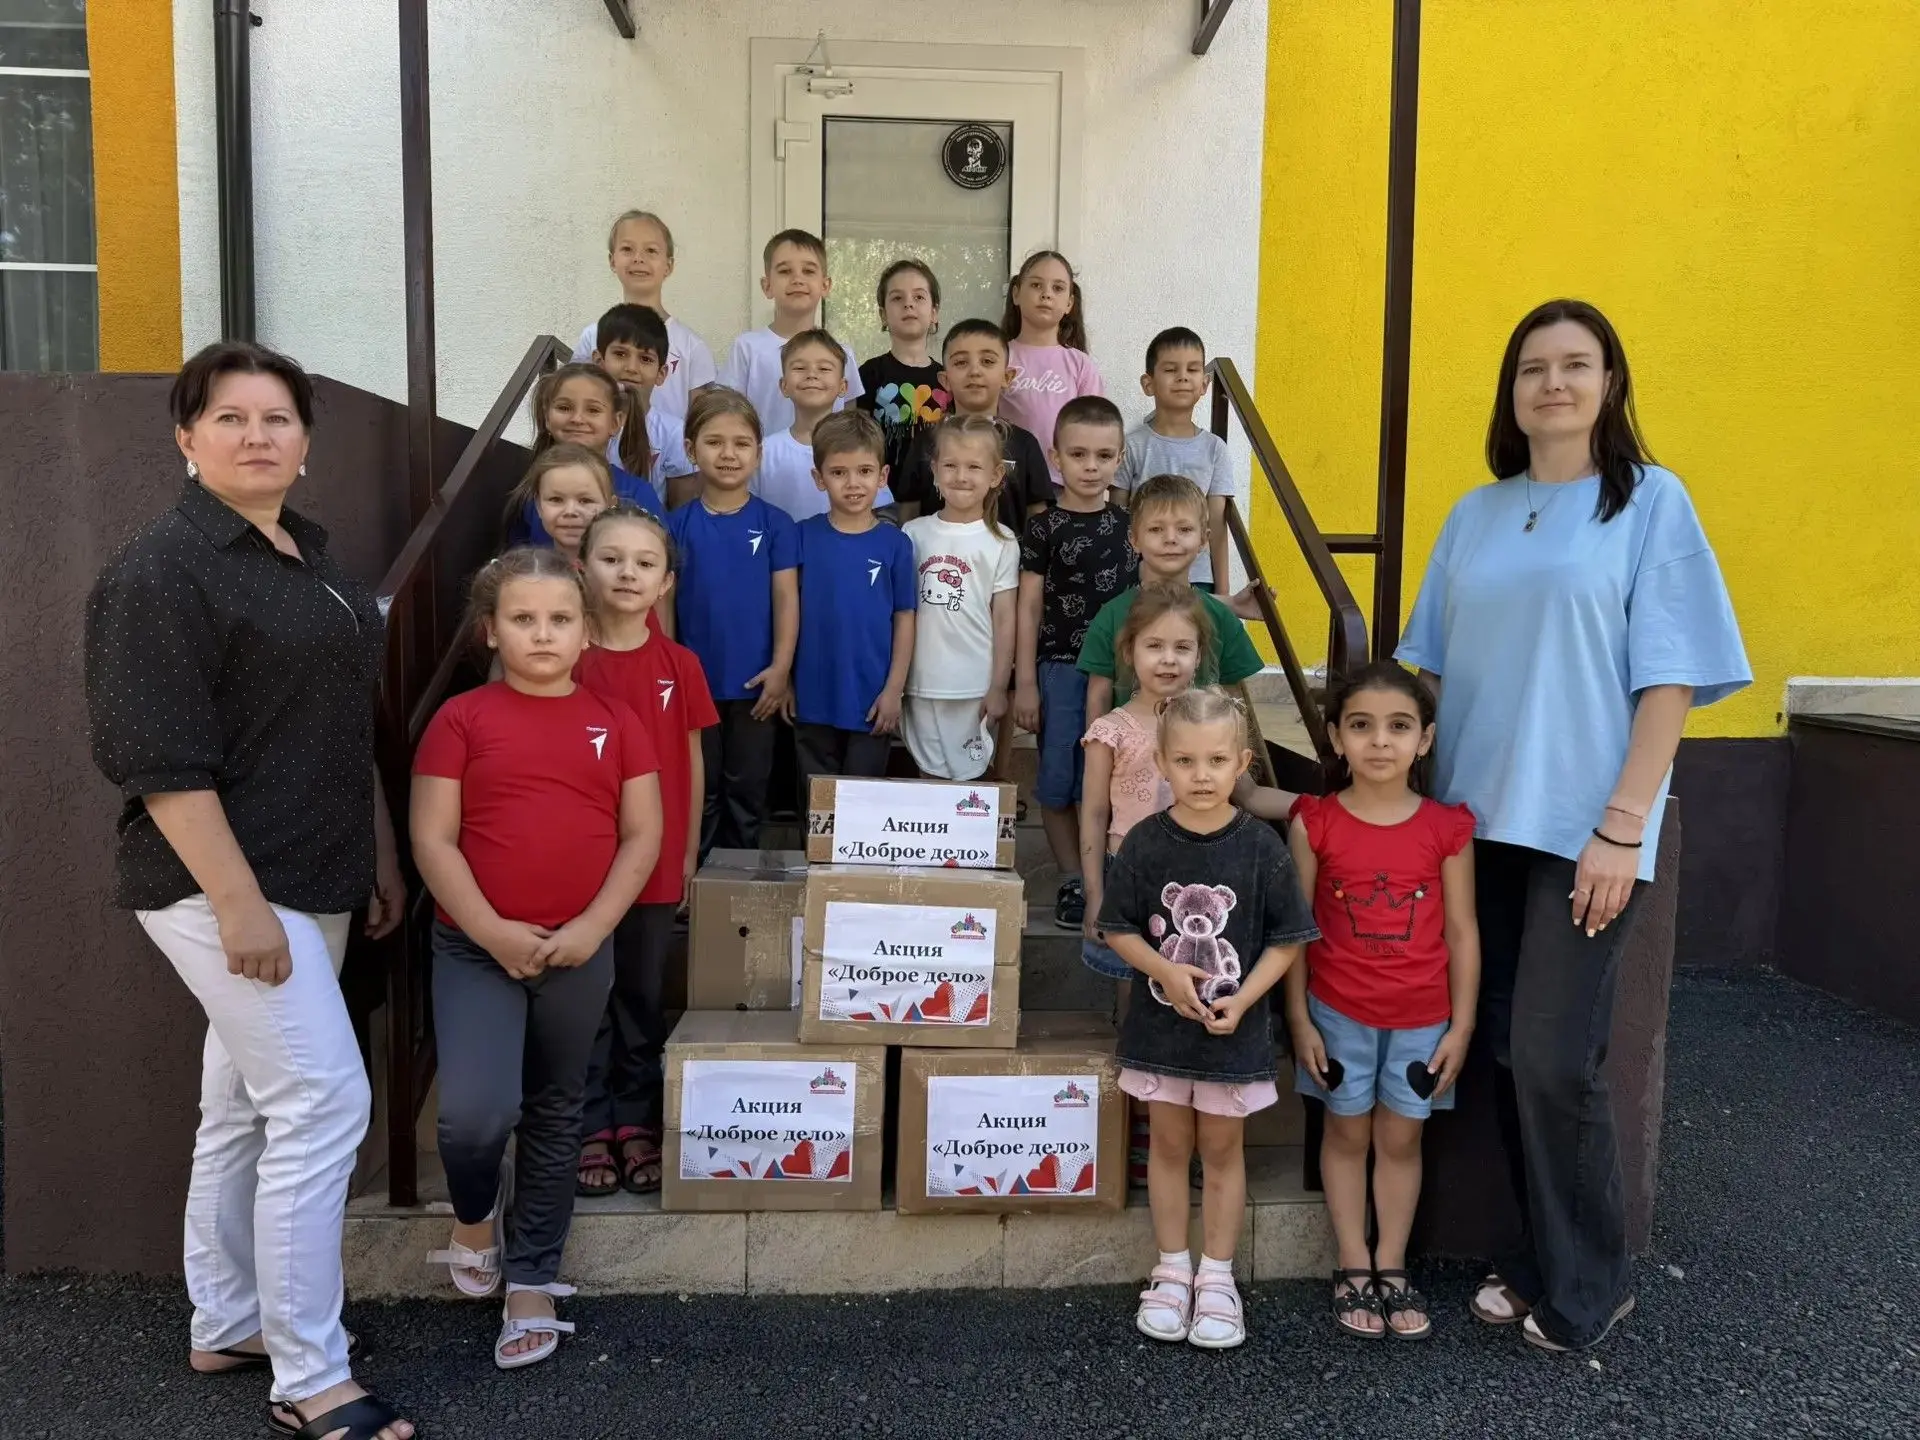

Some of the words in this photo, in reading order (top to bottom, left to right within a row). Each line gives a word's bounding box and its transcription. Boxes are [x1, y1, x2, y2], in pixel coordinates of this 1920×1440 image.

[882, 816, 948, 836] Акция
[838, 842, 926, 862] «Доброе
[930, 848, 989, 862] дело»
[873, 940, 942, 959] Акция
[828, 964, 918, 986] «Доброе
[924, 971, 986, 984] дело»
[731, 1097, 802, 1116] Акция
[977, 1112, 1046, 1130] Акция
[686, 1124, 778, 1143] «Доброе
[784, 1128, 846, 1142] дело»
[932, 1140, 1024, 1158] «Доброе
[1028, 1141, 1090, 1156] дело»
